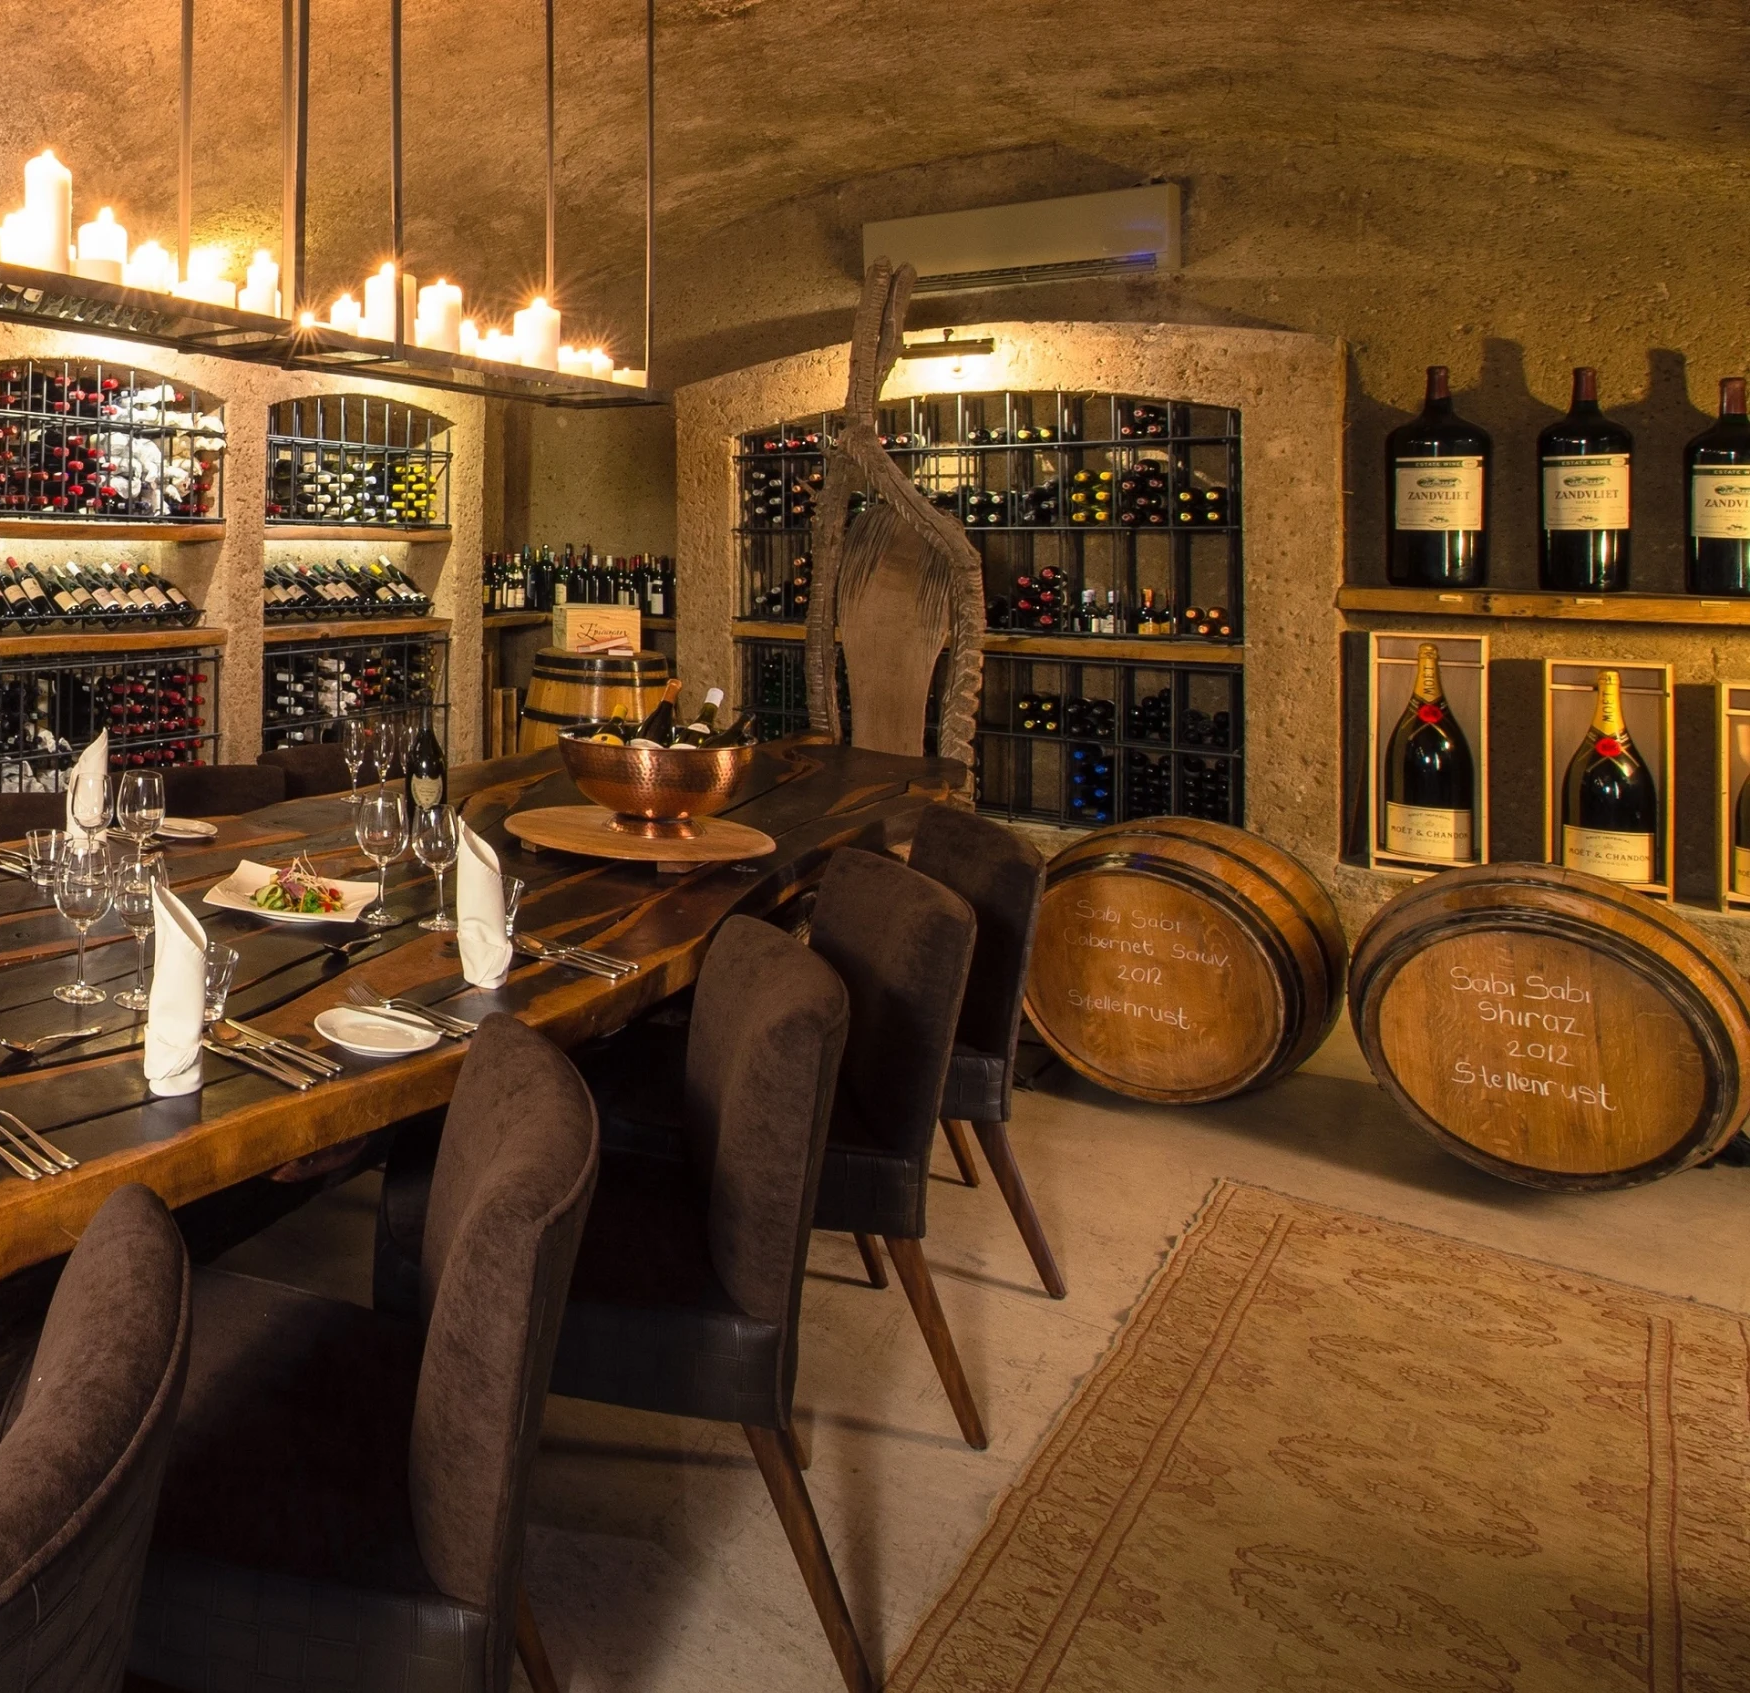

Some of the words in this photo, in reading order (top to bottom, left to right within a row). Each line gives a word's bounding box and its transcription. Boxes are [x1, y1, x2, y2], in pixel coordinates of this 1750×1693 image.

[1407, 491, 1470, 500] ZANDVLIET
[1554, 489, 1619, 500] ZANDVLIET
[1704, 498, 1750, 508] ZANDV
[1426, 830, 1468, 839] CHANDON
[1605, 853, 1650, 862] CHANDON
[1075, 900, 1121, 924] Sabi
[1131, 909, 1181, 933] Sabi
[1063, 926, 1154, 956] Cabernet
[1117, 964, 1163, 986] 2012
[1450, 966, 1515, 997] Sabi
[1522, 975, 1591, 1004] Sabi
[1478, 1000, 1586, 1037] Shiraz
[1506, 1040, 1575, 1067] 2012
